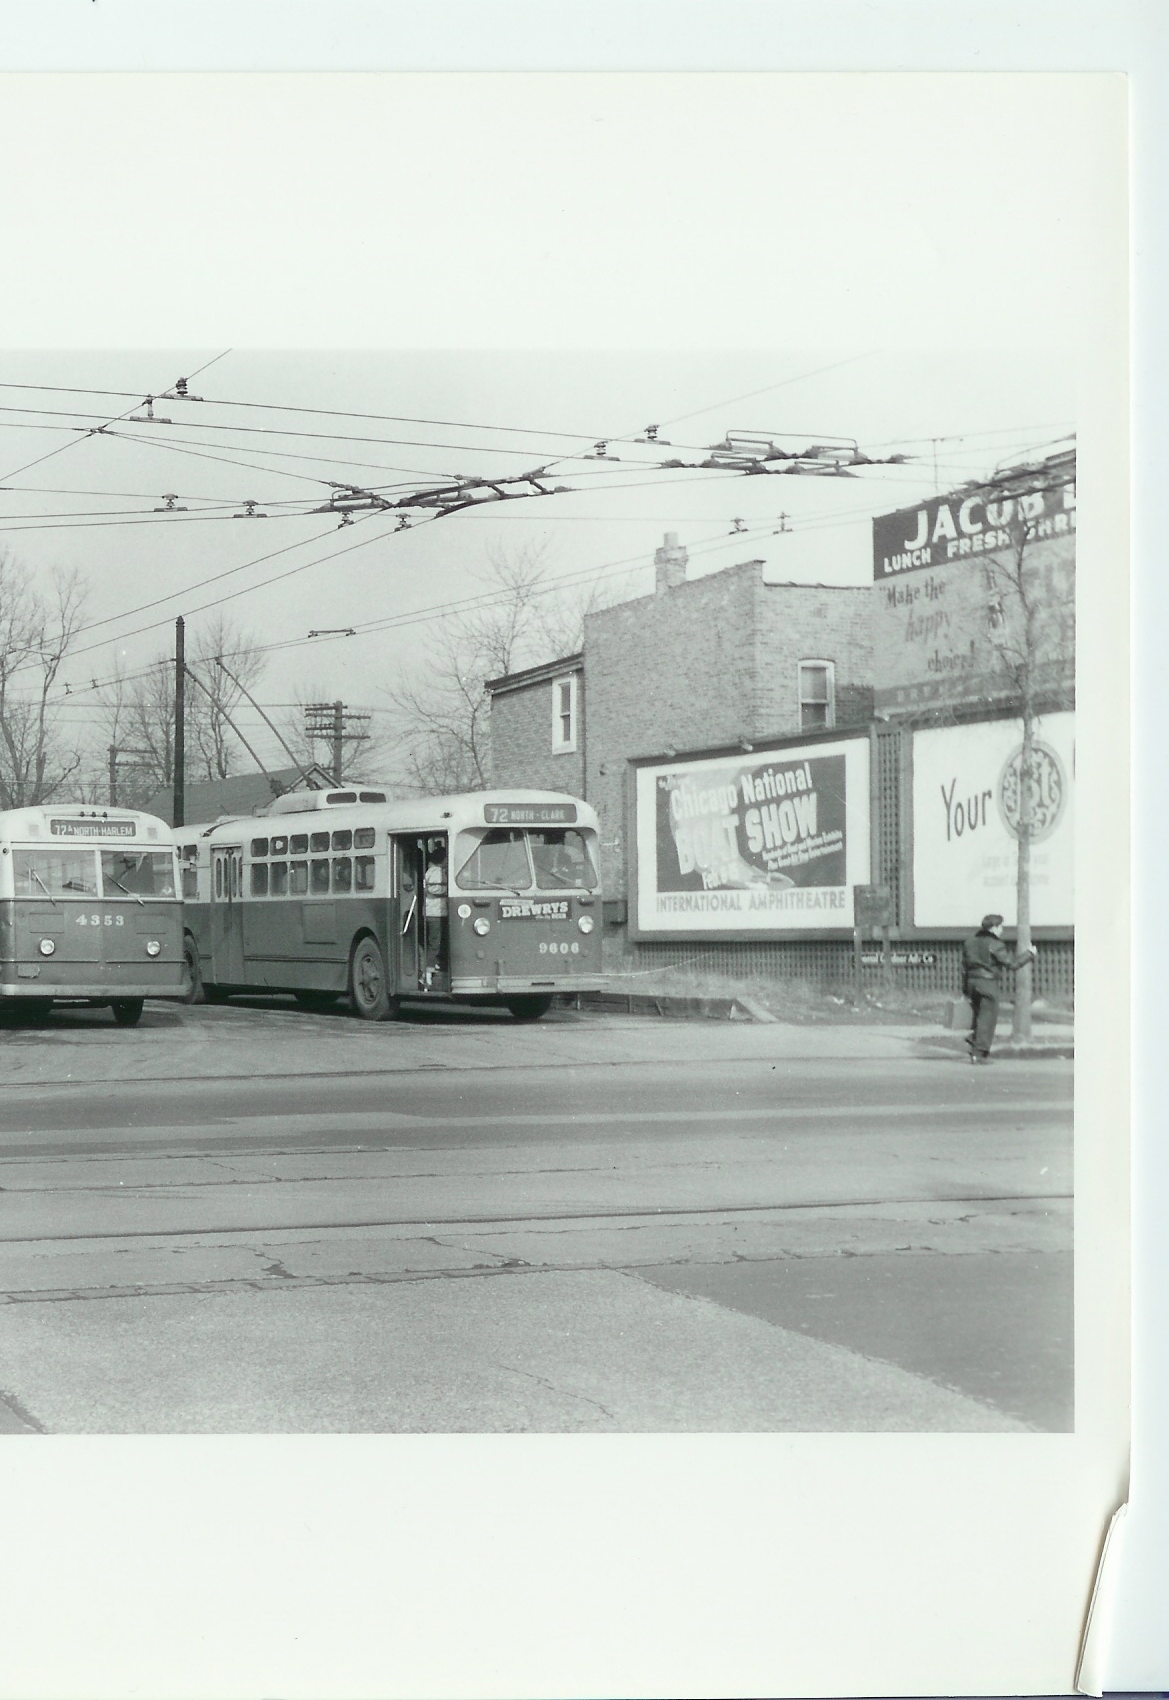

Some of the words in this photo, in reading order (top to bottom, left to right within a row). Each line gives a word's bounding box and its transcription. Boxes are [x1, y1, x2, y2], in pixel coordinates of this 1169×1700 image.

[884, 547, 931, 573] LUNCH
[947, 526, 1010, 558] FRESH
[925, 576, 946, 600] the
[670, 783, 738, 822] Chicago
[741, 762, 813, 804] National
[491, 808, 508, 822] 72
[511, 809, 534, 820] NORTH
[541, 809, 564, 820] CLARK
[941, 778, 992, 841] Your
[745, 792, 818, 853] SHOW
[502, 902, 568, 918] DREWRYS
[656, 895, 742, 912] INTERNATIONAL
[748, 891, 845, 910] AMPHITHEATRE
[75, 914, 124, 926] 4353
[539, 942, 579, 954] 9606
